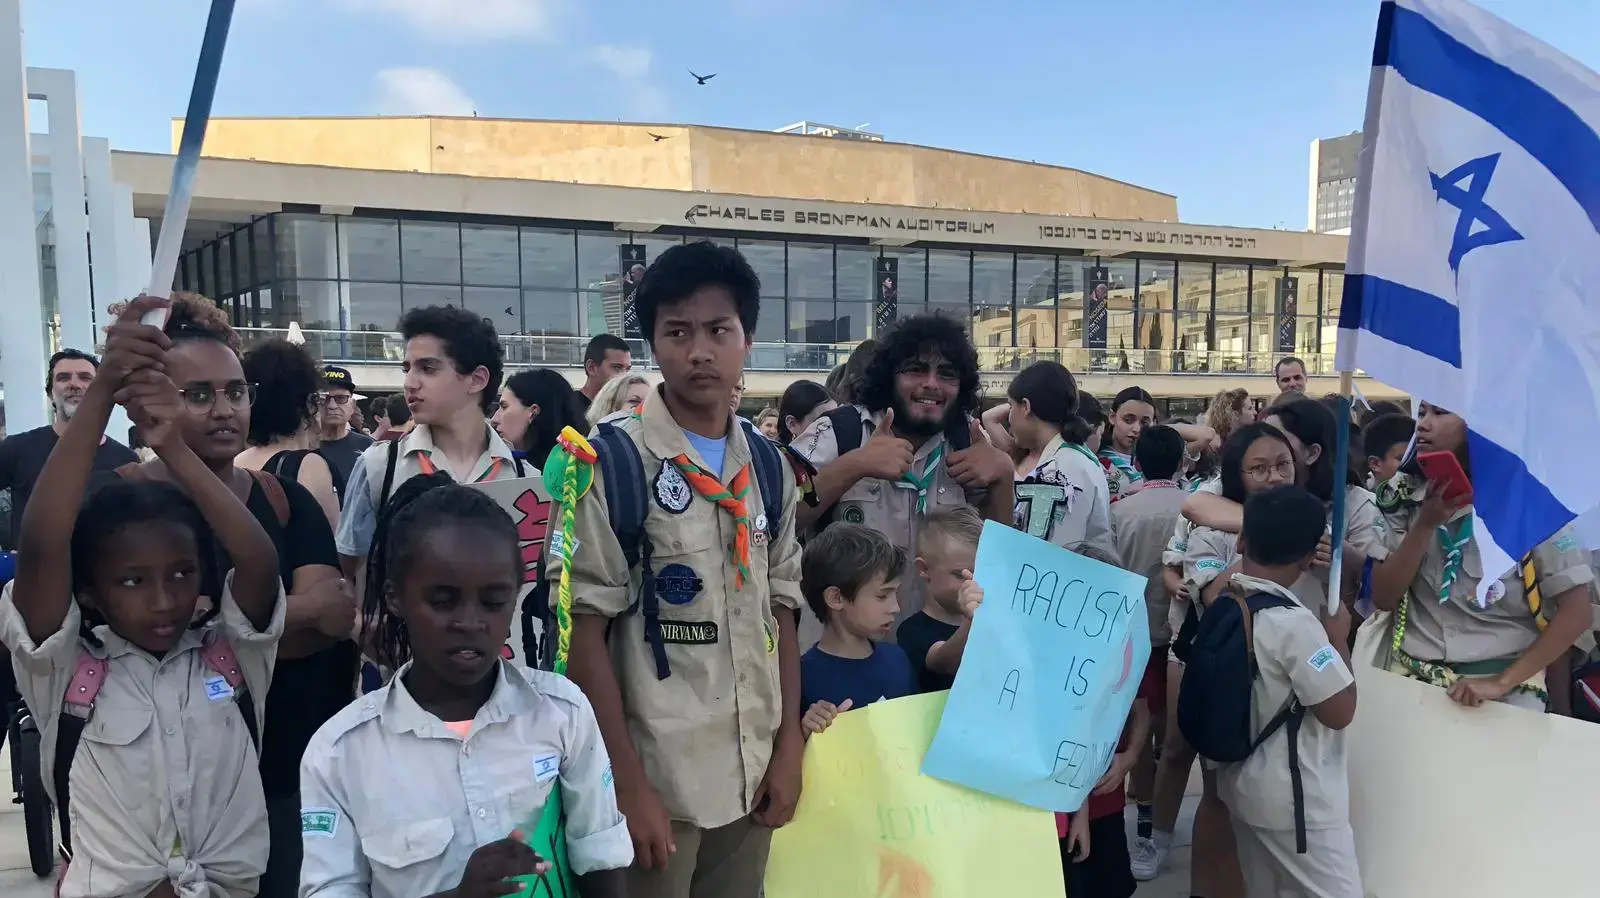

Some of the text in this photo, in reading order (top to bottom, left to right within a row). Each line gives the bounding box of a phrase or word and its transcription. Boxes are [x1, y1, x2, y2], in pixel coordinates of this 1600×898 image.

[696, 204, 995, 234] CHARLES BRONFMAN AUDITORIUM
[1039, 225, 1097, 240] ברונפמן
[1170, 233, 1222, 247] התרבות
[1225, 234, 1256, 249] היכל
[1011, 563, 1139, 644] RACISM
[660, 624, 706, 641] NIRVANA
[1064, 656, 1096, 696] IS
[998, 669, 1020, 711] A
